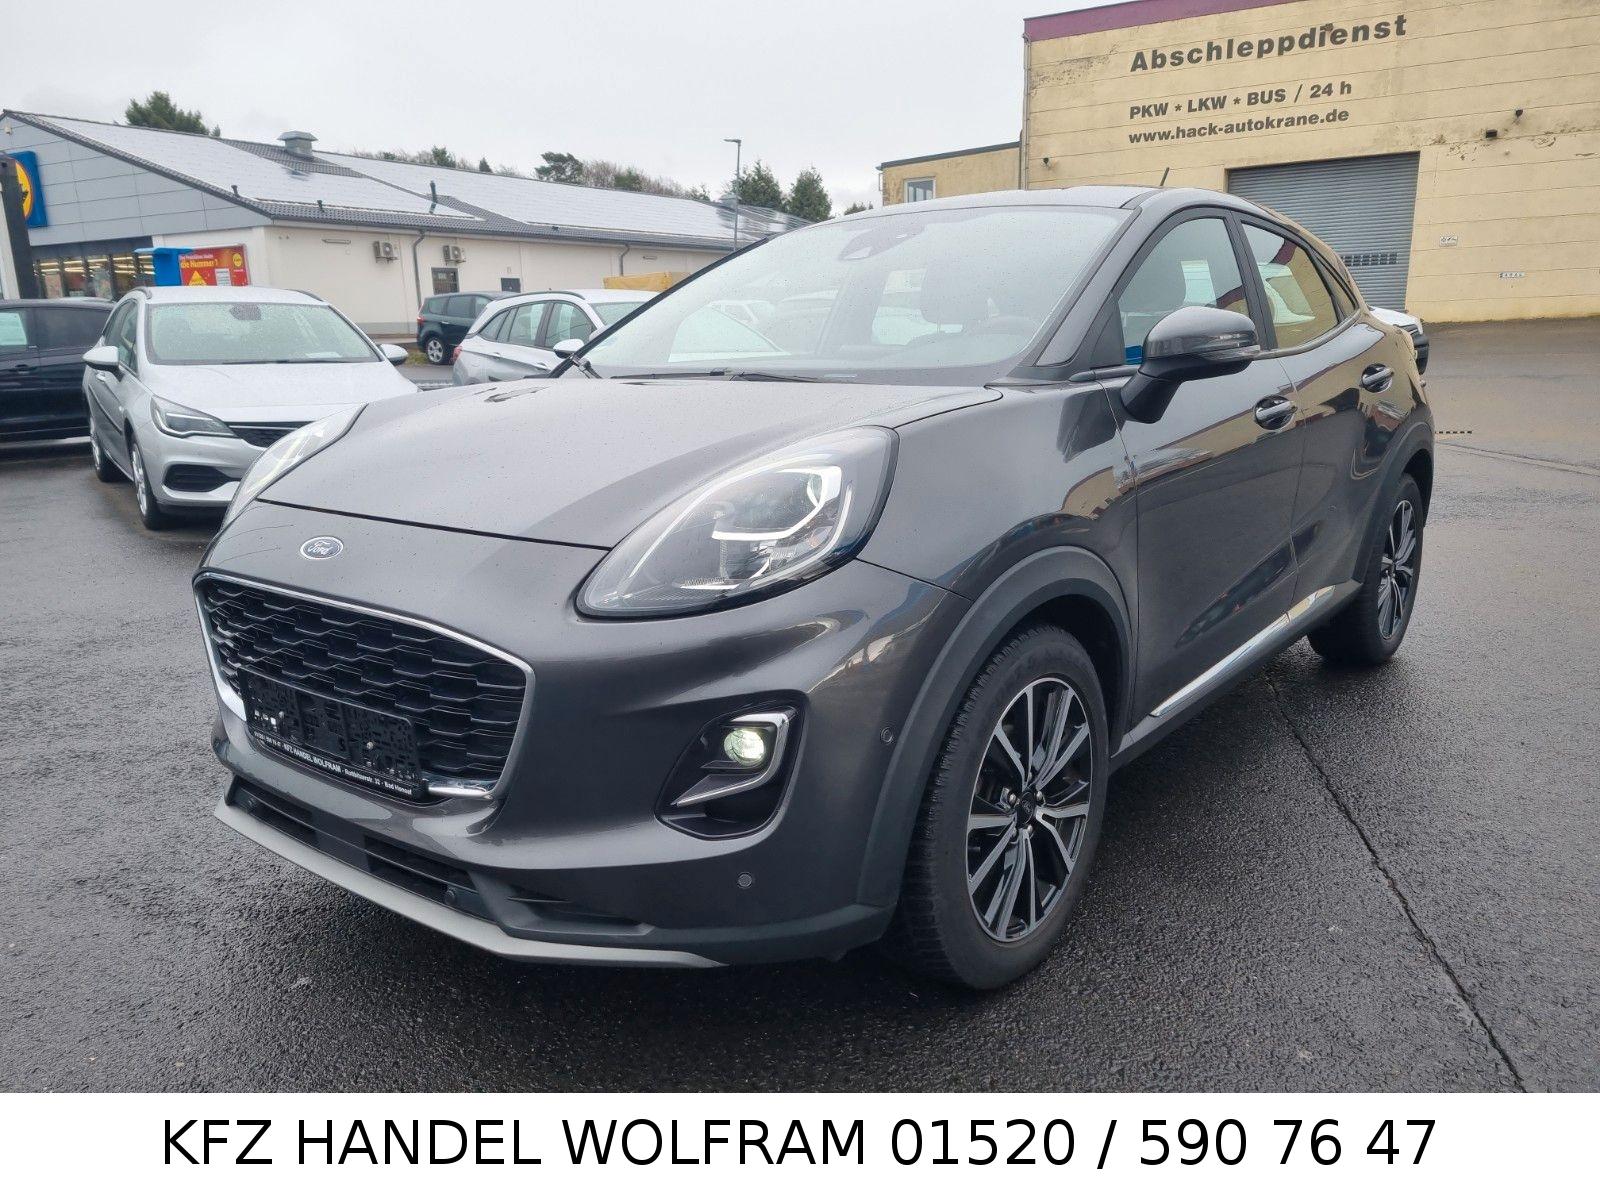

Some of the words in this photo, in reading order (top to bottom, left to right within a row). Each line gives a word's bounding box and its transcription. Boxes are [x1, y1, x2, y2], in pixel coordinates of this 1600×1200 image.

[1130, 14, 1407, 72] Abschleppdienst
[1129, 102, 1169, 120] PKW
[1187, 95, 1228, 113] LKW
[1246, 88, 1286, 106] BUS
[1293, 84, 1303, 103] /
[1309, 82, 1333, 99] 24
[1340, 81, 1352, 95] h
[1128, 108, 1350, 143] www.hack-autokrane.de
[293, 747, 313, 762] HANDEL
[312, 756, 342, 772] WOLFRAM
